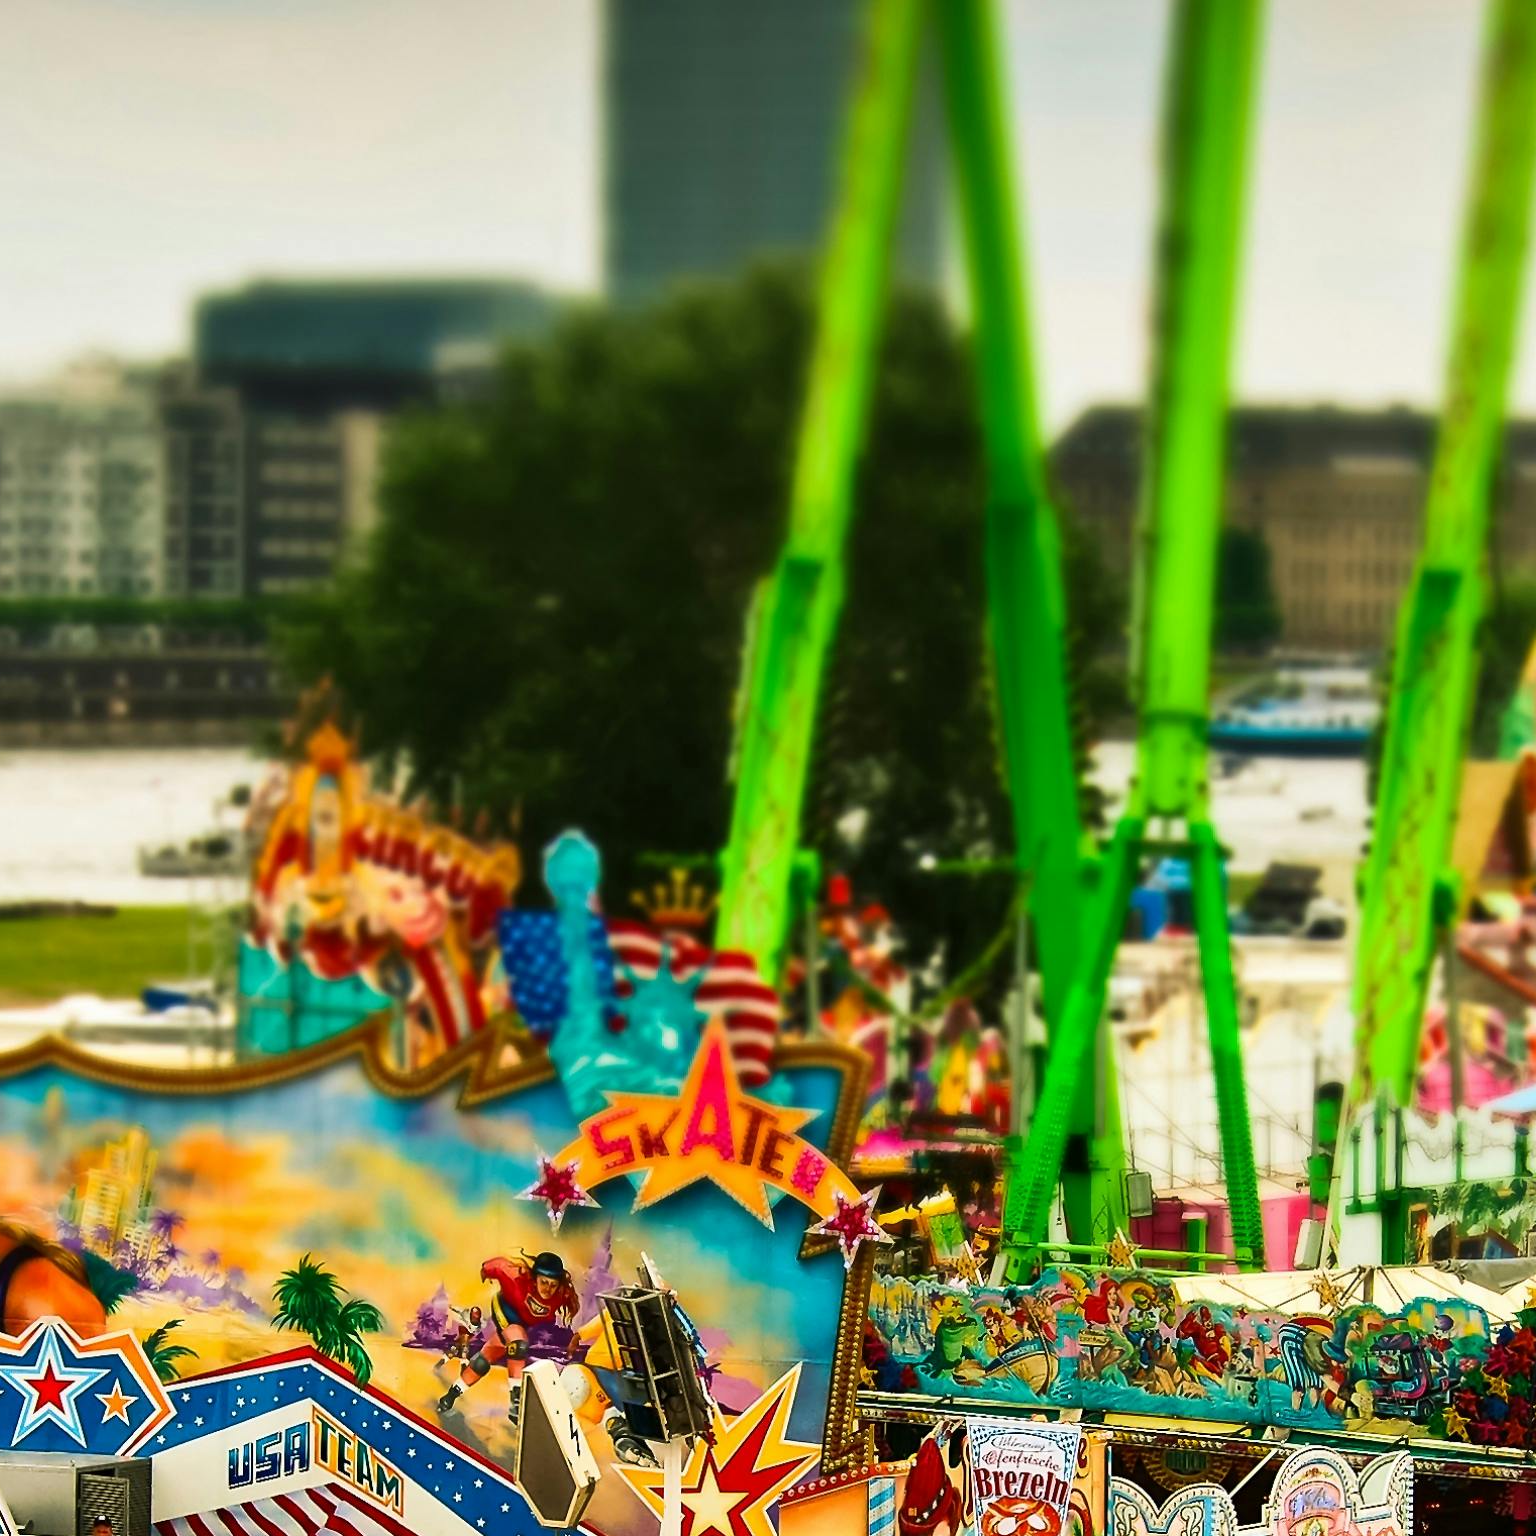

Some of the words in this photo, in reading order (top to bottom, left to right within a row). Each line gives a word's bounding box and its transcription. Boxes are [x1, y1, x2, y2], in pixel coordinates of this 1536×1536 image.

[228, 1421, 311, 1490] USA
[315, 1414, 400, 1508] TEAM
[973, 1467, 1069, 1505] Brezeln
